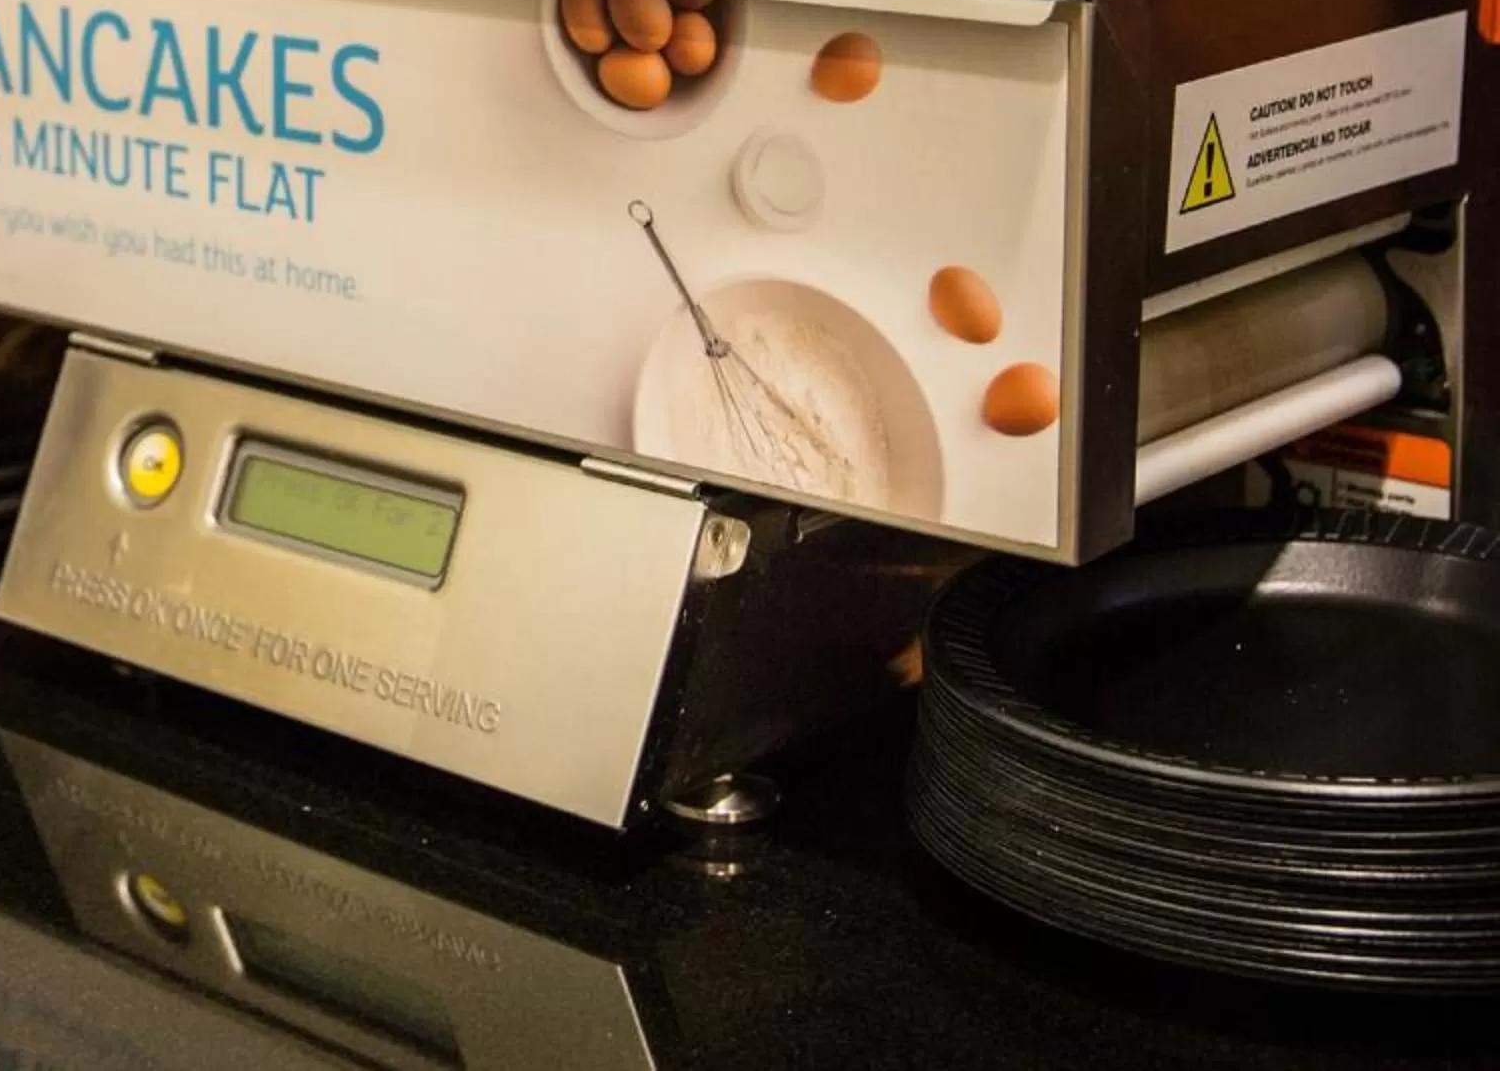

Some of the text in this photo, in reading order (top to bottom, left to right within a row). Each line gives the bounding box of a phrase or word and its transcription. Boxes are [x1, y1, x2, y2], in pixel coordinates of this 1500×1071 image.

[1299, 90, 1315, 109] DO
[1316, 84, 1338, 103] NOT
[1339, 74, 1373, 98] TOUCH
[1321, 130, 1336, 145] NO
[1338, 119, 1372, 142] TOCAR
[12, 117, 190, 200] MINUTE
[208, 150, 326, 223] FLAT
[50, 212, 99, 243] wish
[102, 226, 148, 258] you
[152, 228, 196, 267] had
[201, 240, 246, 278] this
[252, 255, 277, 284] at
[284, 255, 363, 304] home.
[142, 456, 165, 474] OK
[51, 560, 131, 613] PRESS
[254, 626, 311, 674] FOR
[311, 648, 374, 693] ONE
[374, 665, 501, 735] SERVING
